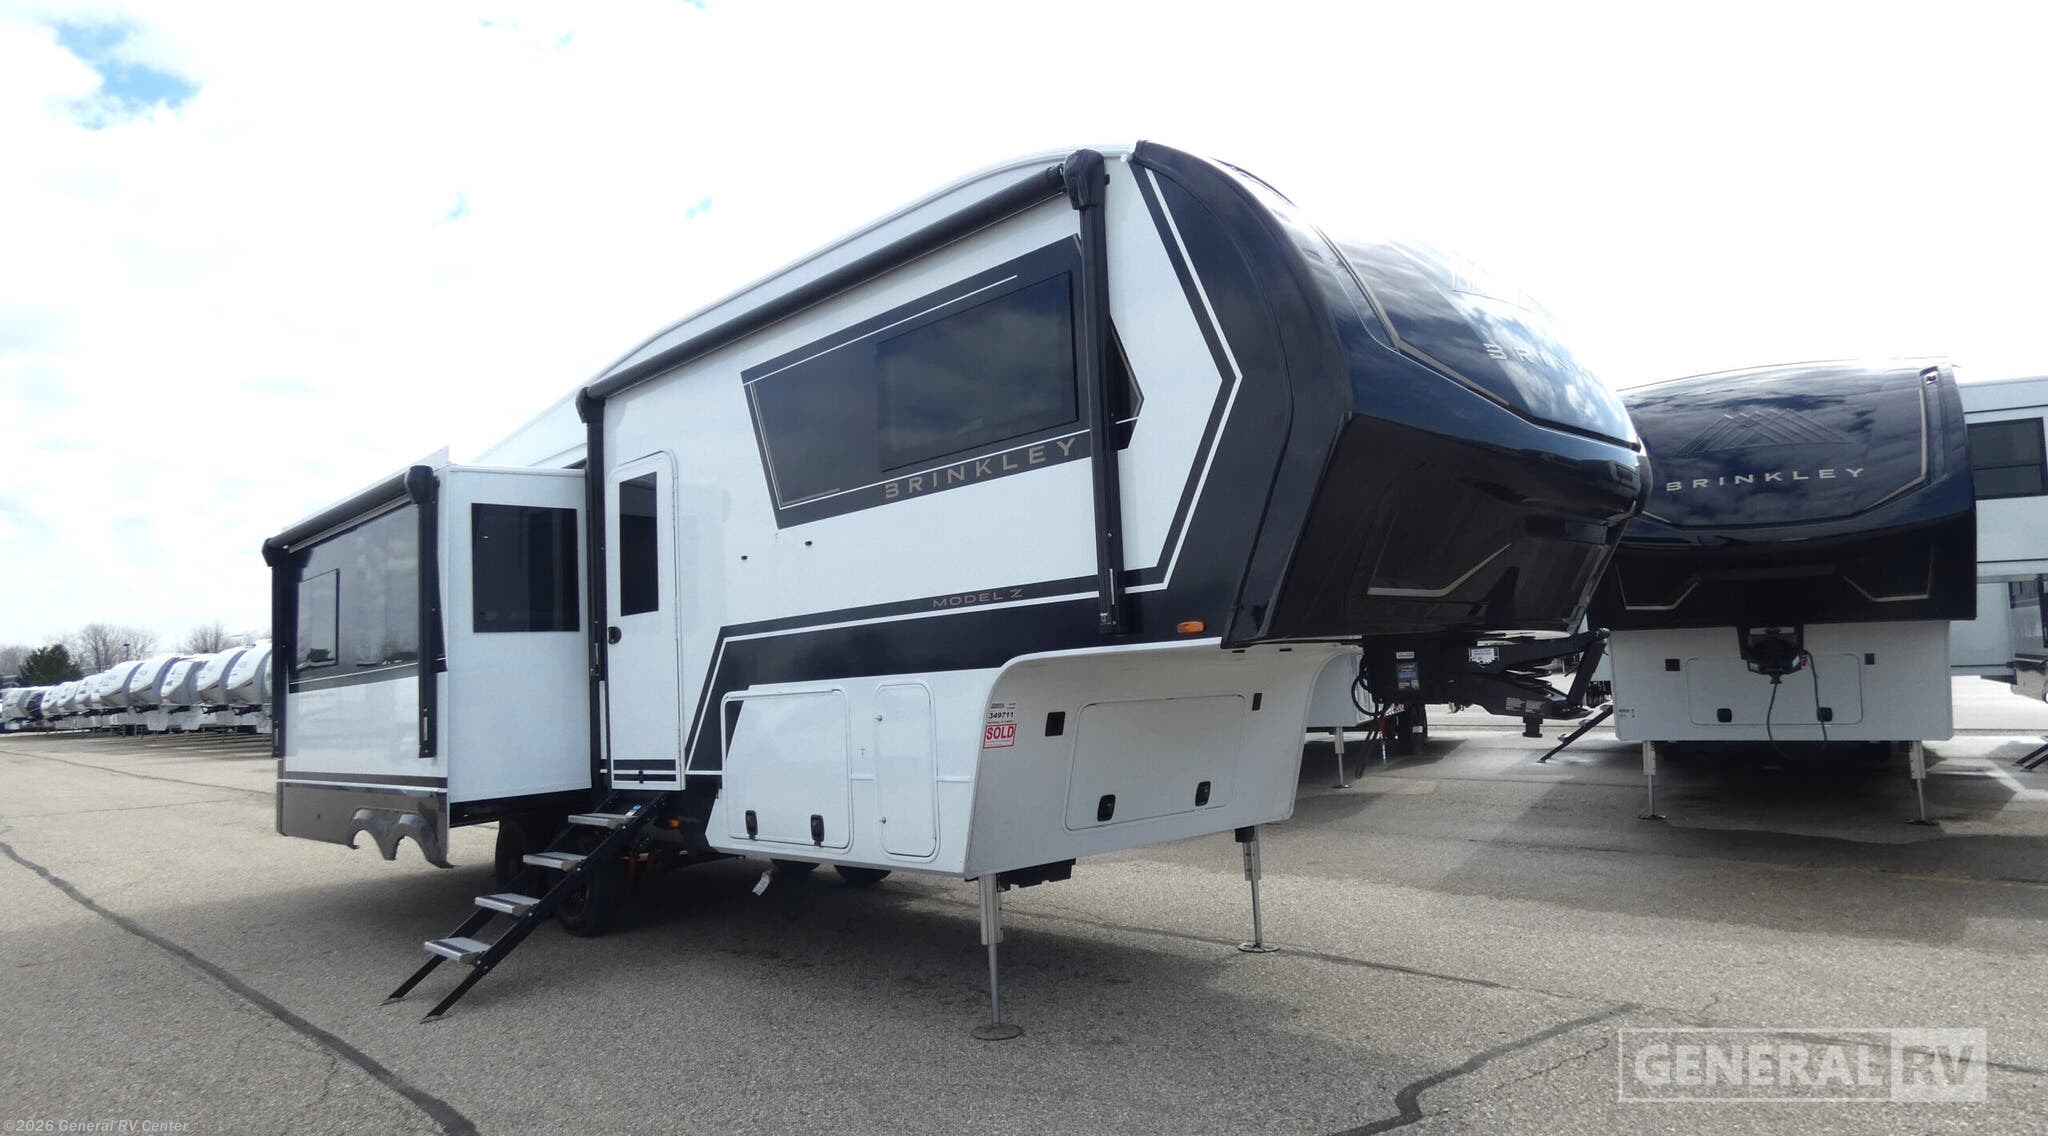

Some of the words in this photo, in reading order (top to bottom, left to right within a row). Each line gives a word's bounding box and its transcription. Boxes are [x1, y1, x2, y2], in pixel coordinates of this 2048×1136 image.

[884, 437, 1076, 499] BRINKLEY
[1666, 467, 1864, 492] BRINKLEY
[932, 592, 1003, 608] MODEL
[1010, 588, 1023, 598] Z
[989, 711, 1014, 719] 349711
[986, 726, 1014, 740] SOLD
